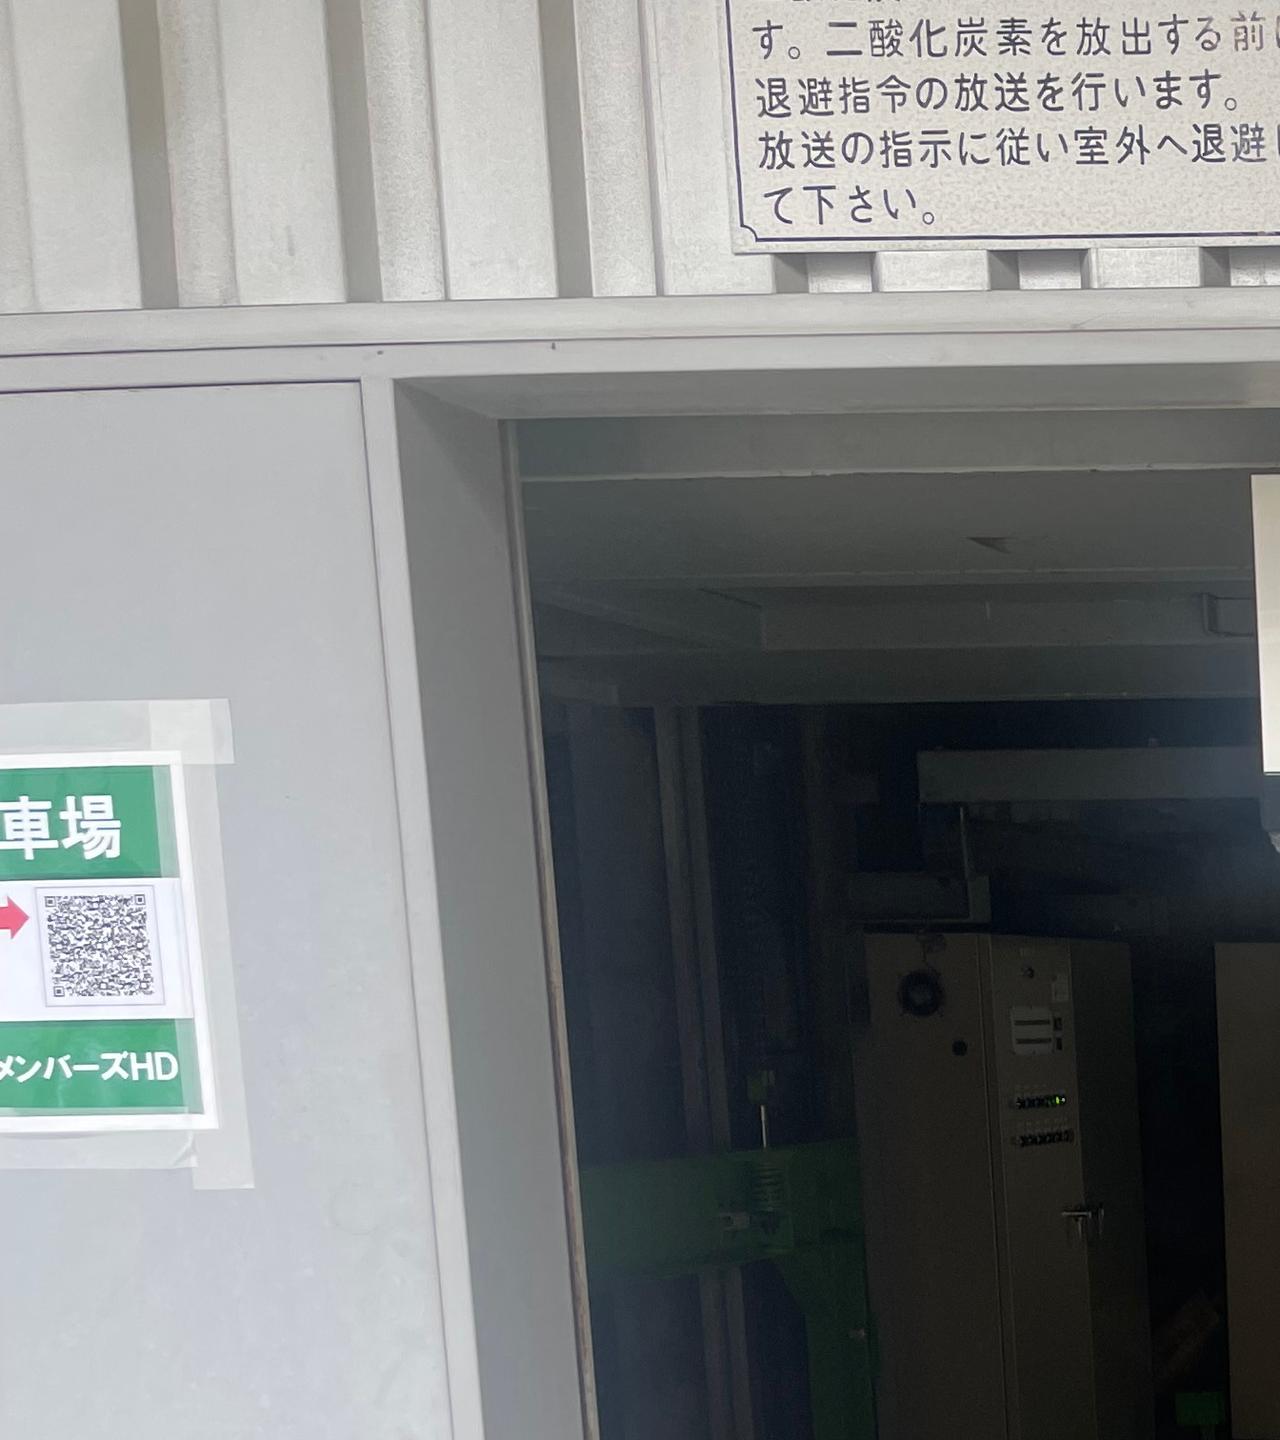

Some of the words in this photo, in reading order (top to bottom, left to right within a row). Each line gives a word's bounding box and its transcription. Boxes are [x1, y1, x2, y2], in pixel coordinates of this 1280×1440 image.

[755, 68, 1238, 119] 退避指令の放送を行います。
[763, 184, 936, 226] て下さい。
